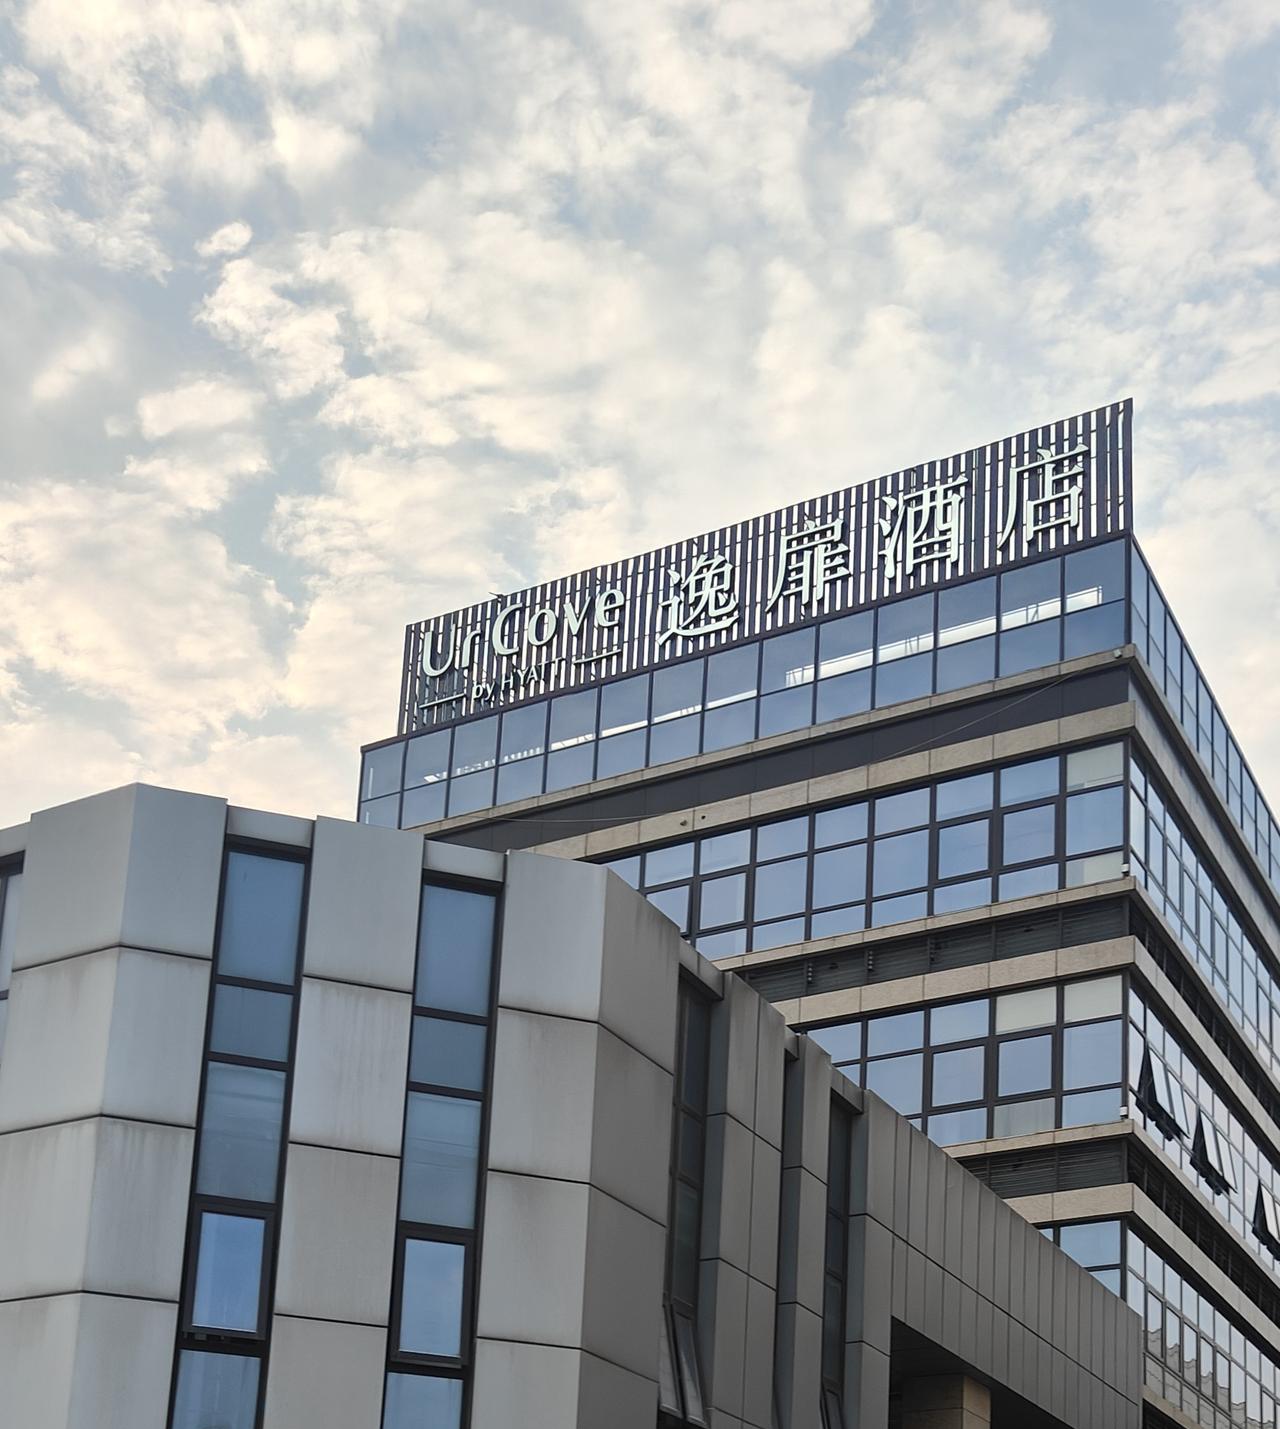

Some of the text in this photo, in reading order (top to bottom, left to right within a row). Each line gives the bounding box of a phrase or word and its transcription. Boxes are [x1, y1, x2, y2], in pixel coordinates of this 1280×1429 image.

[657, 444, 1091, 646] 逸扉酒店
[473, 656, 566, 701] by HYATT
